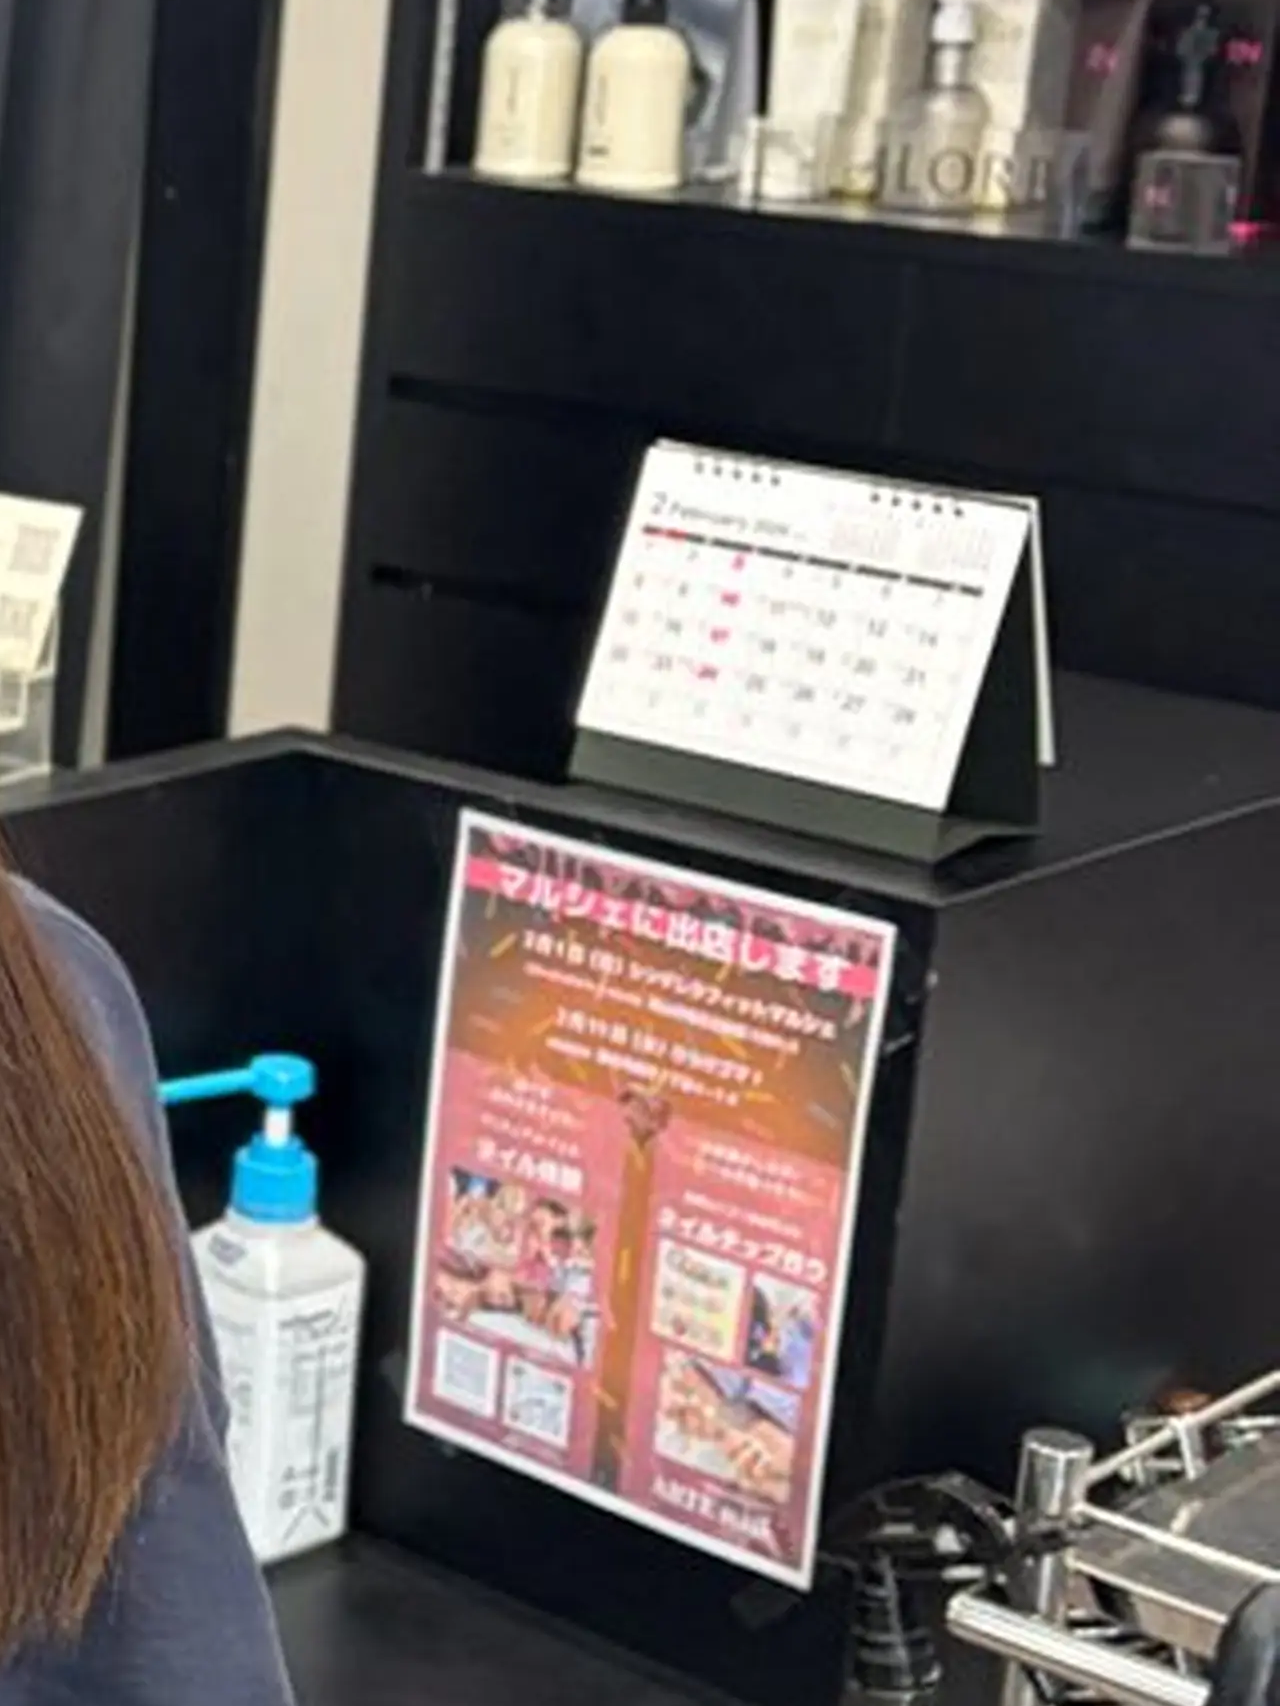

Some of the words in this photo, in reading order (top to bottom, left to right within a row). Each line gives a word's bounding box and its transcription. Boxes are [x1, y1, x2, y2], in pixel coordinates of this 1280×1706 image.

[499, 862, 850, 991] マルシェに出店します
